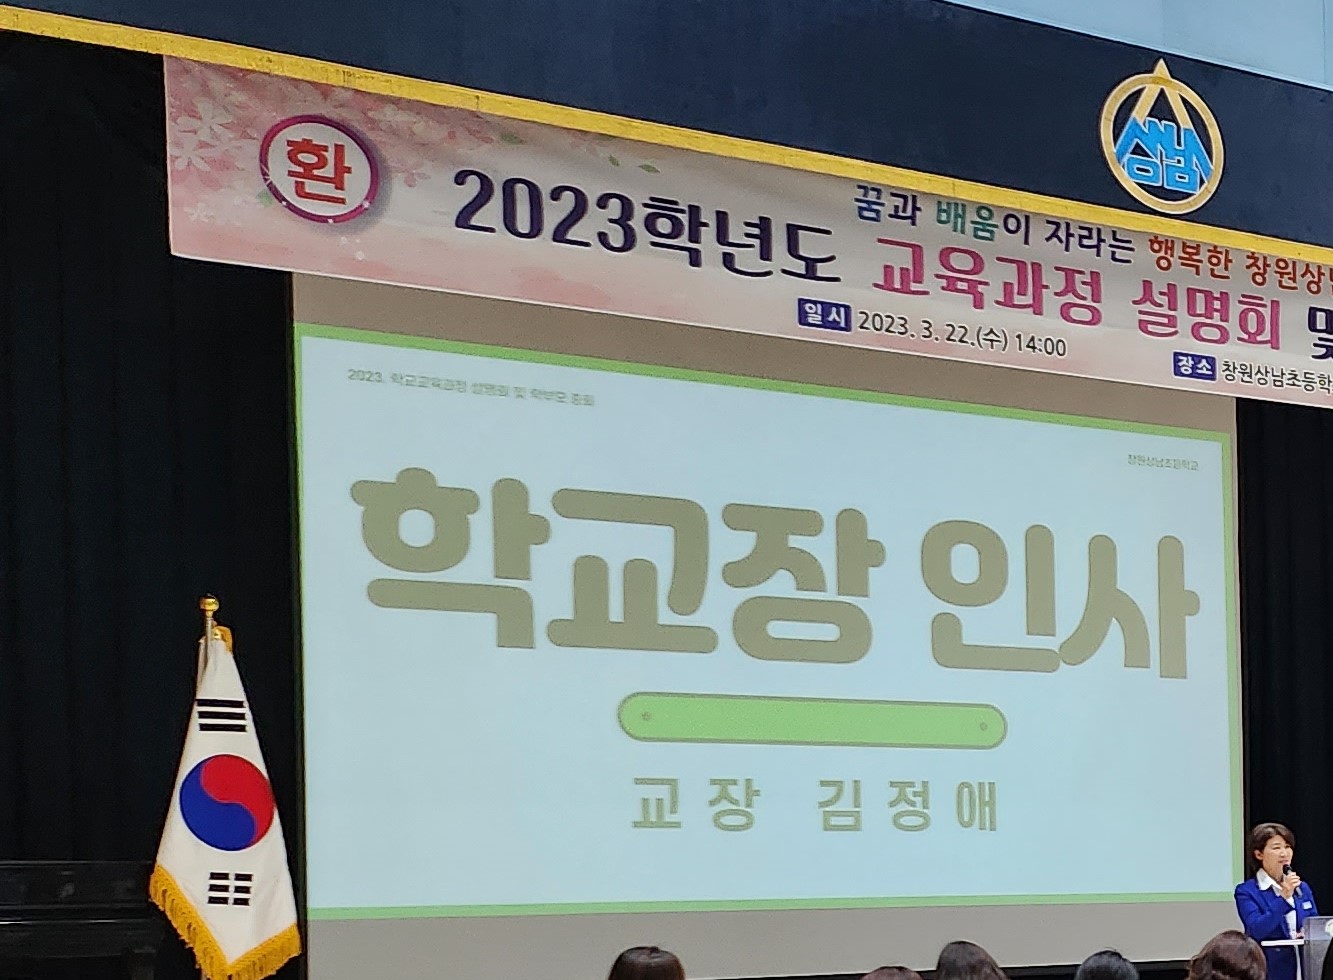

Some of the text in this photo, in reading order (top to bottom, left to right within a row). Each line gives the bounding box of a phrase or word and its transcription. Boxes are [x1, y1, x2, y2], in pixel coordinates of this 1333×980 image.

[285, 137, 352, 205] 환
[453, 168, 842, 285] 2023학년도
[872, 237, 1103, 329] 교육과정
[1131, 279, 1282, 352] 설명회
[853, 184, 921, 226] 꿈과
[935, 199, 1031, 246] 배움이
[1044, 219, 1136, 265] 자라는
[1148, 235, 1233, 281] 행복한
[803, 302, 847, 329] 일시
[858, 311, 916, 341] 2023.
[945, 322, 1010, 354] 22.(수)
[1014, 331, 1067, 359] 14:00
[1176, 355, 1214, 379] 장소
[350, 467, 1200, 680] 학교장 인사
[631, 776, 999, 833] 교장 김정애
